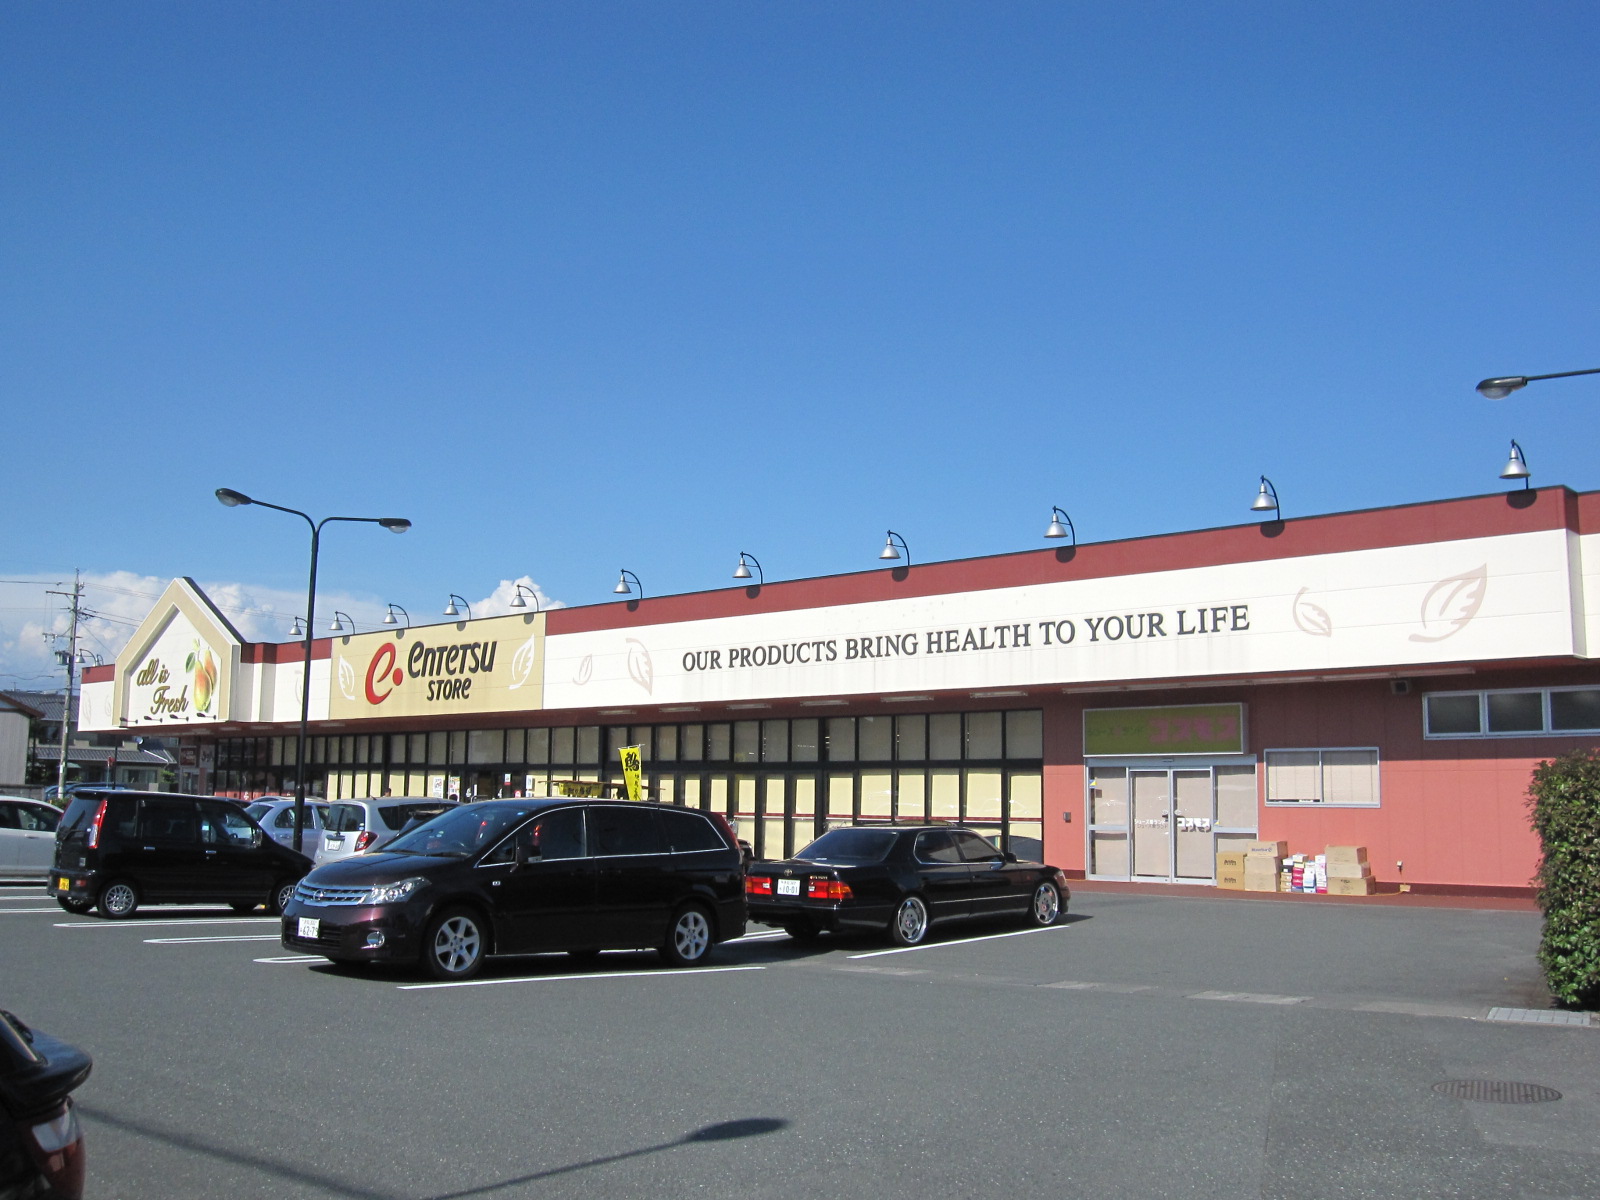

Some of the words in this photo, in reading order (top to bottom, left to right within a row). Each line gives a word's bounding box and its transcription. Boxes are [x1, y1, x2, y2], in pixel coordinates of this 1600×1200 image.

[682, 650, 723, 672] OUR
[728, 639, 838, 668] PRODUCTS
[845, 632, 919, 660] BRING
[926, 623, 1031, 654] HEALTH
[1038, 619, 1076, 646] TO
[1084, 612, 1168, 642] YOUR
[1176, 604, 1251, 636] LIFE
[136, 658, 159, 687] all
[158, 663, 170, 684] is
[150, 684, 190, 715] Fresh
